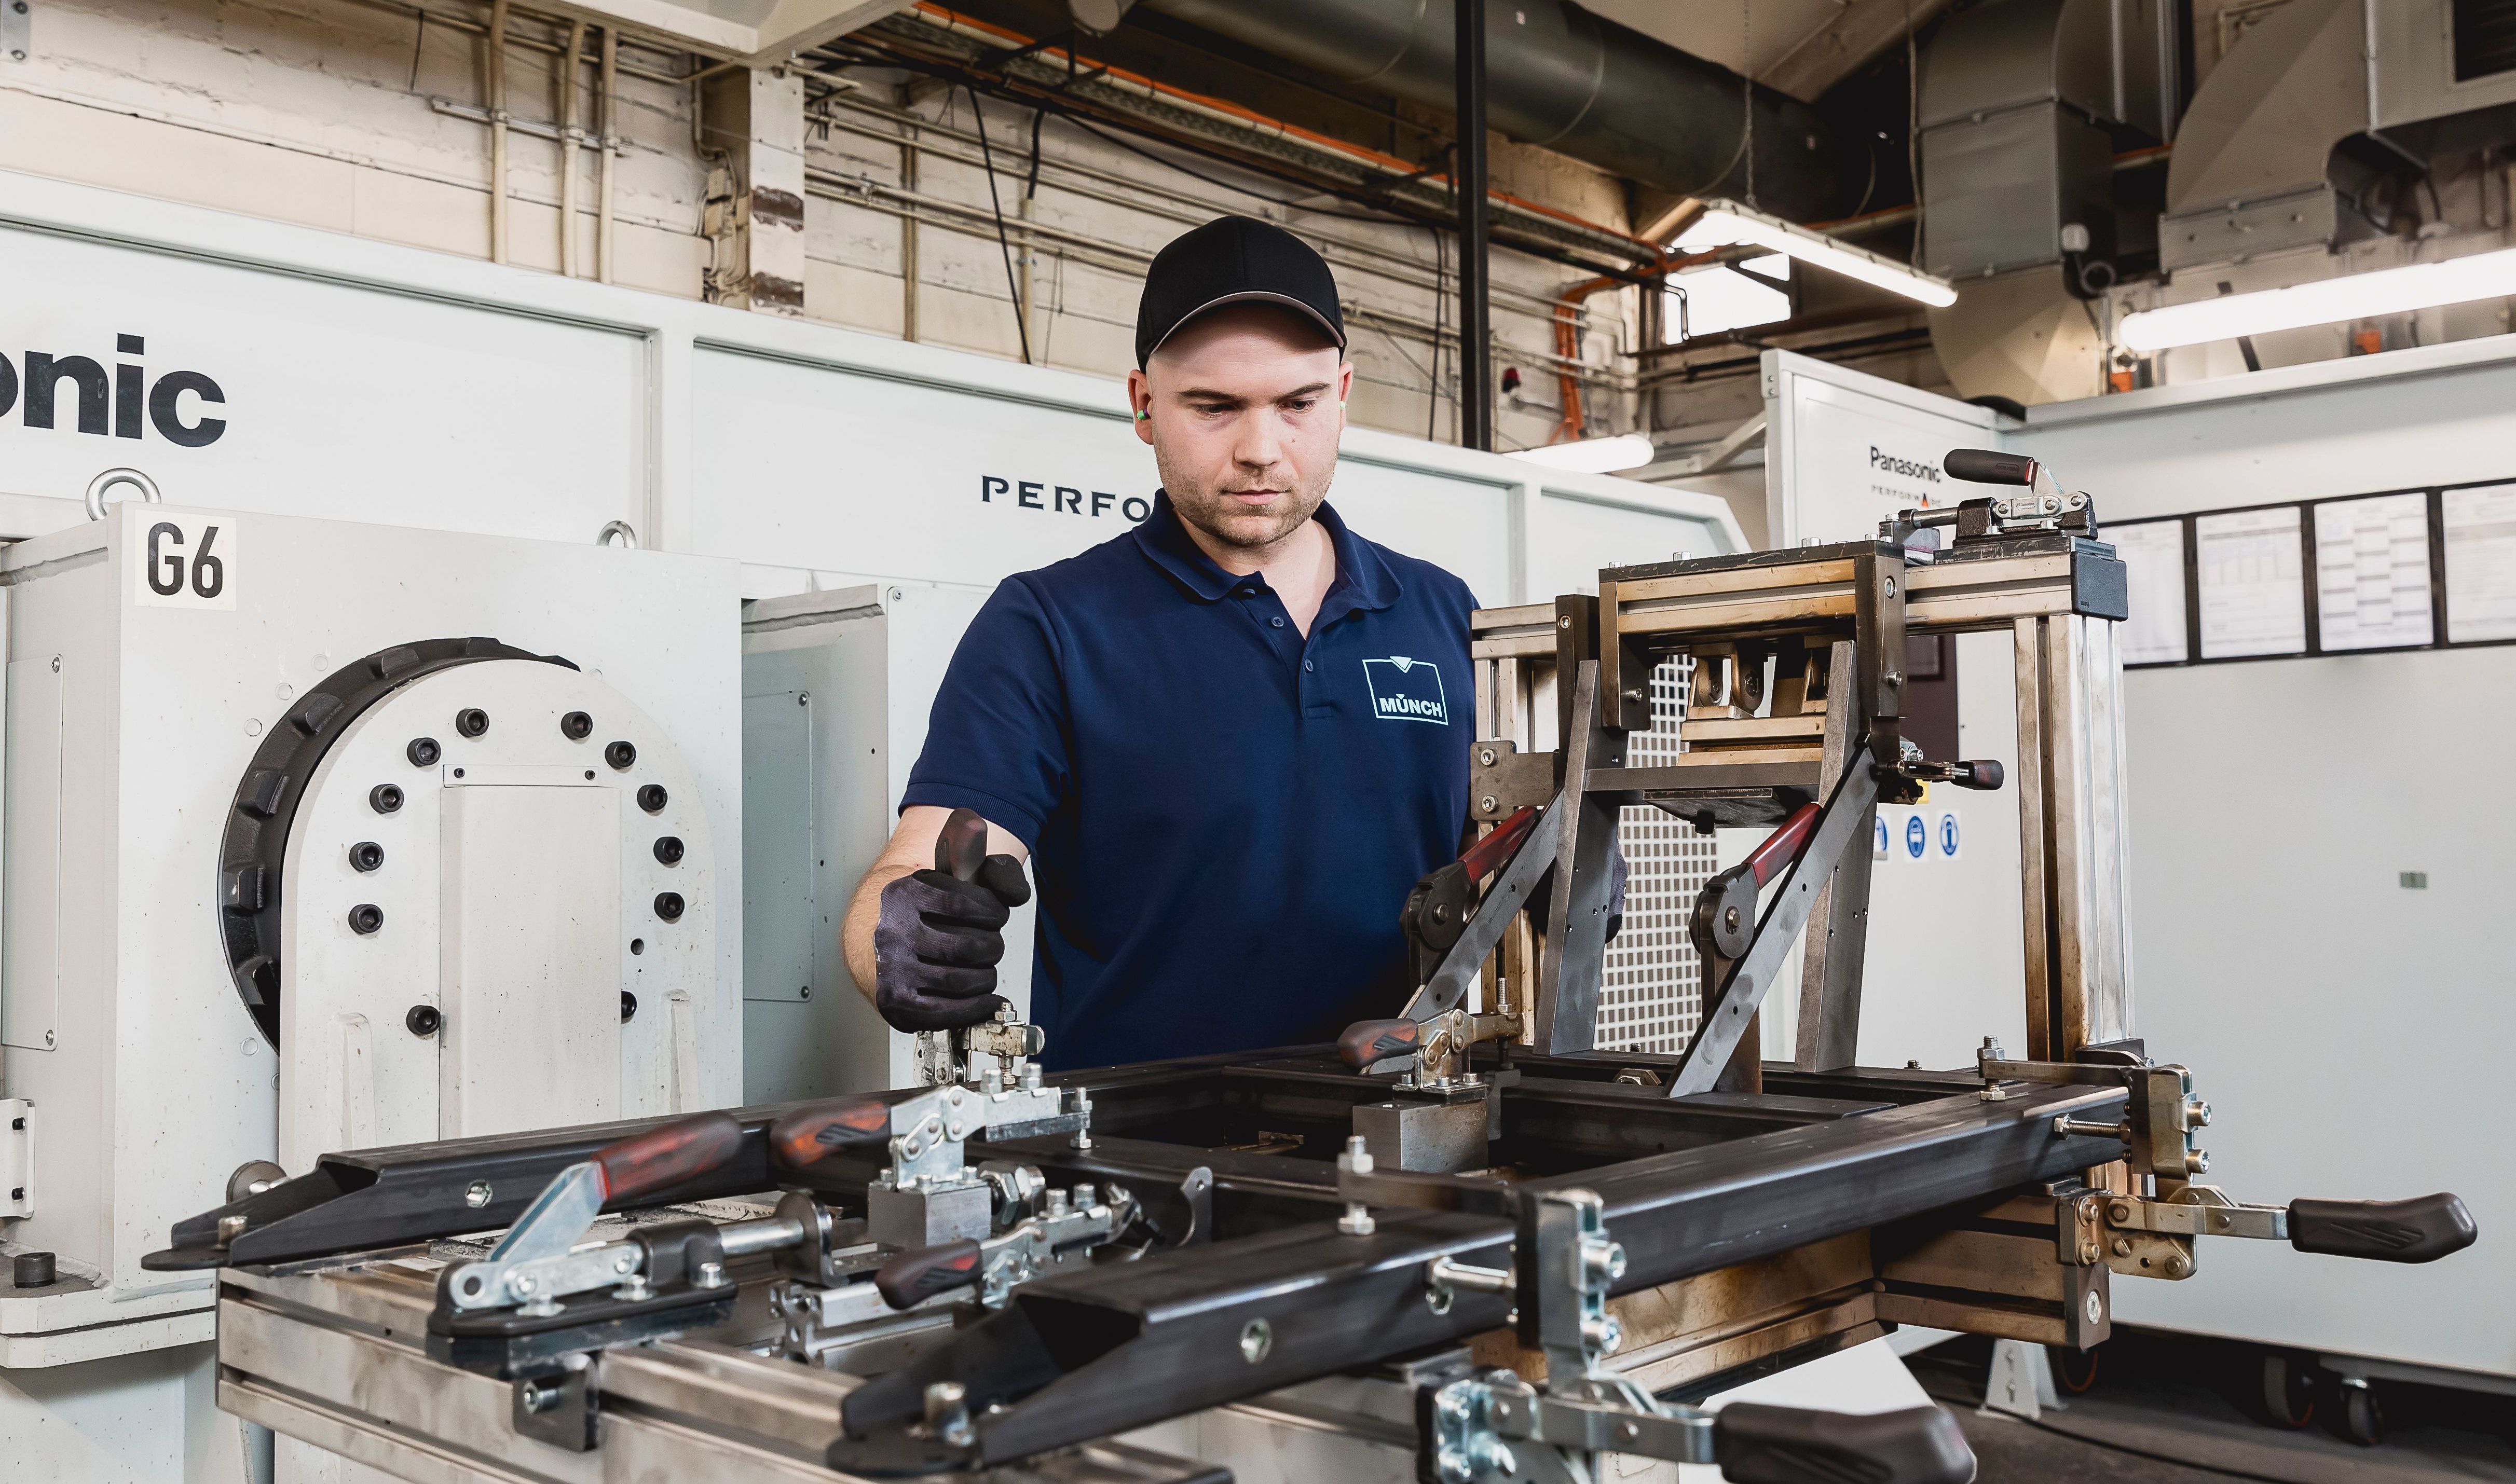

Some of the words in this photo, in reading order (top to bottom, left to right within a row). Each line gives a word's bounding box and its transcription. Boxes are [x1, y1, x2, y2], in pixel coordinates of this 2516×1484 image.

[0, 333, 226, 447] nic
[1870, 446, 1941, 483] Panasonic
[981, 475, 1151, 523] PERFO
[148, 522, 223, 599] G6
